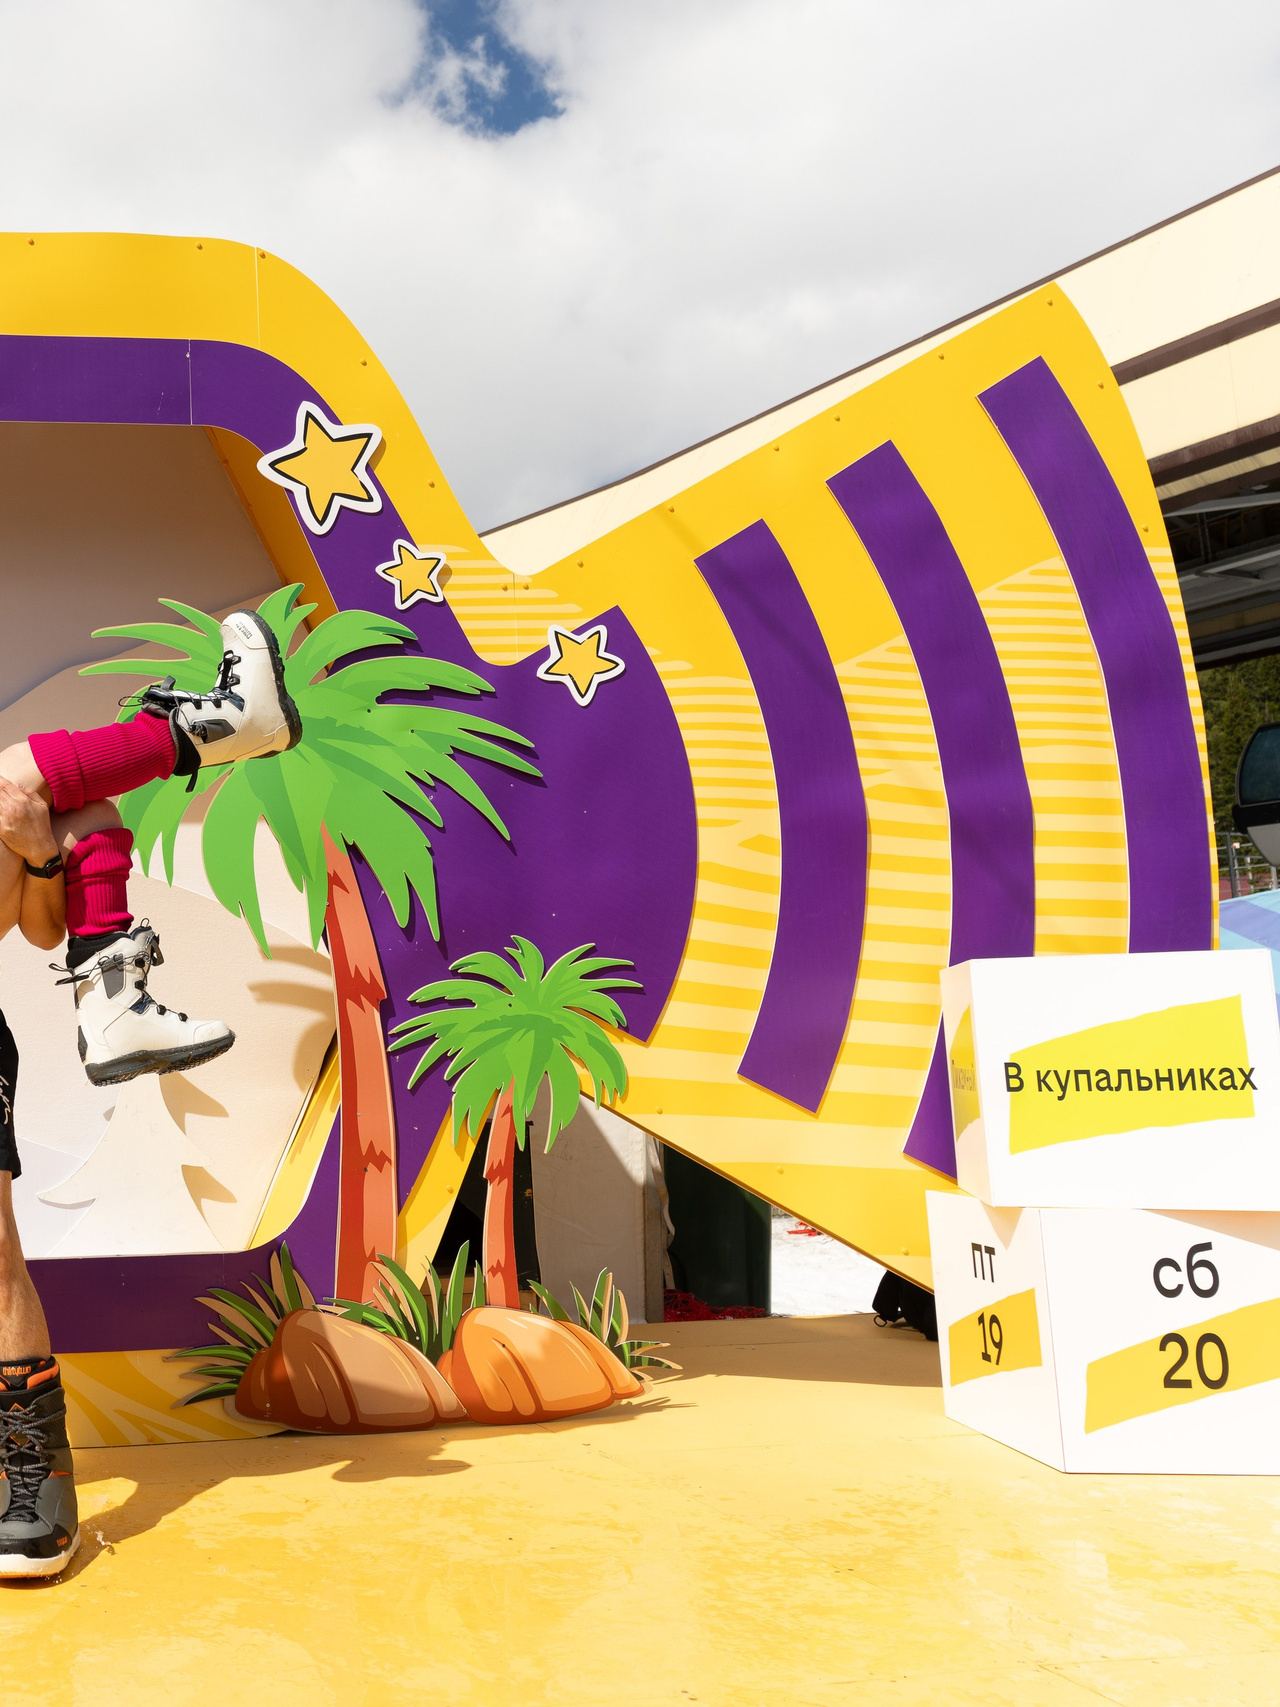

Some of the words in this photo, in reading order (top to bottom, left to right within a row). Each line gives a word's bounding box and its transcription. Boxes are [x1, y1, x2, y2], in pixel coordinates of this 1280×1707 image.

[1004, 1061, 1025, 1093] В
[1036, 1061, 1258, 1100] купальниках
[1152, 1241, 1221, 1299] сб
[977, 1312, 1004, 1367] 19
[1159, 1332, 1230, 1391] 20
